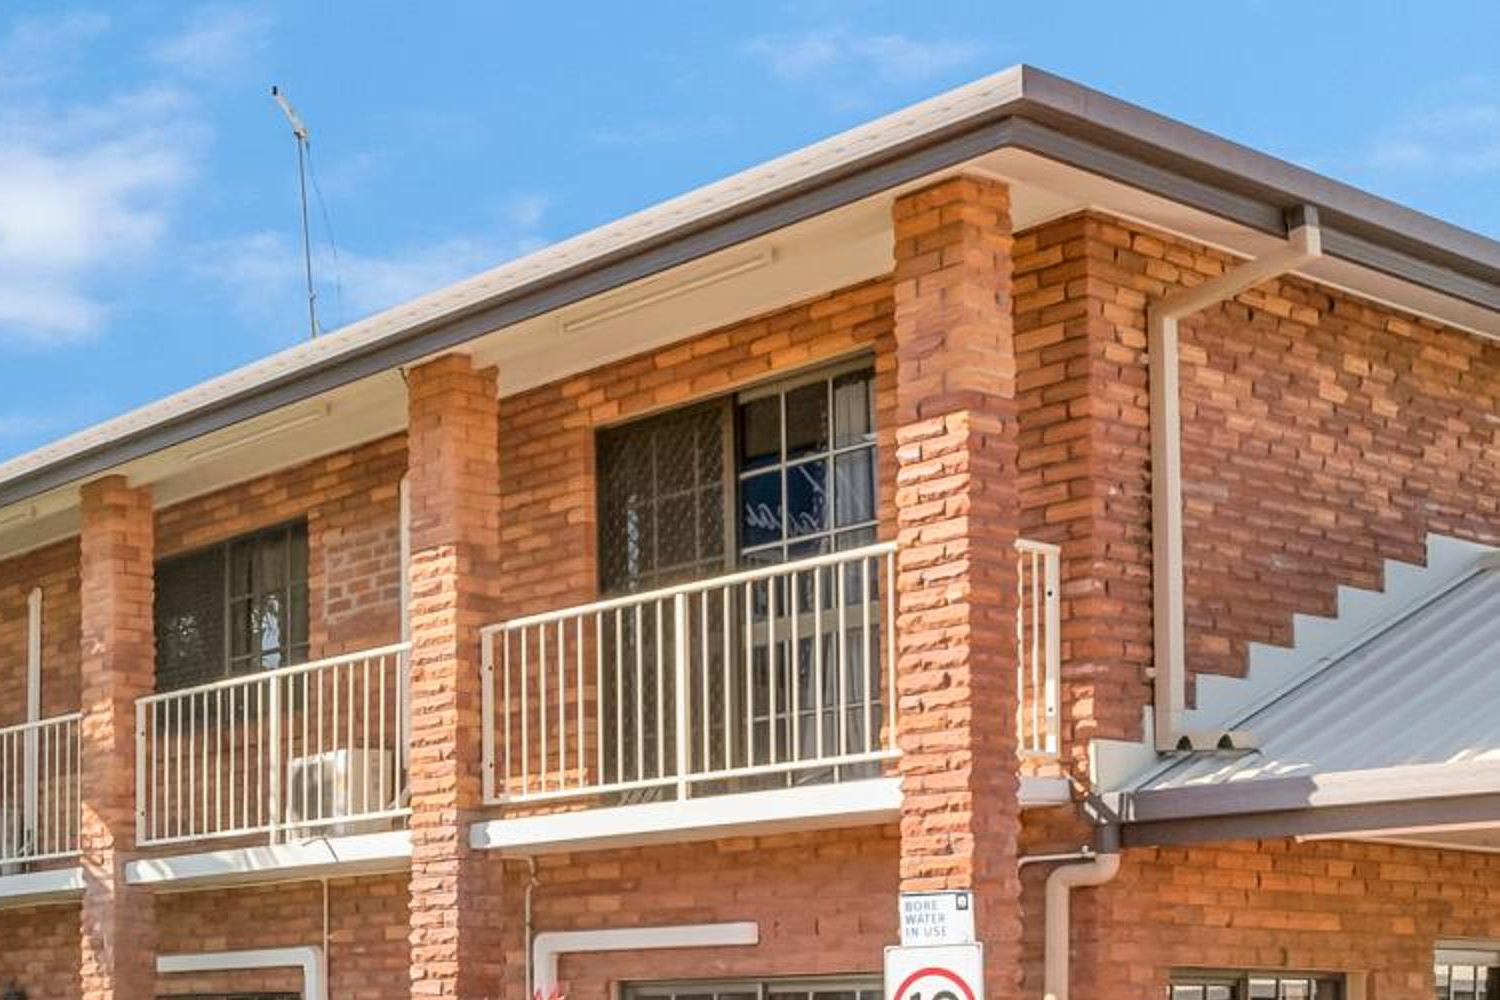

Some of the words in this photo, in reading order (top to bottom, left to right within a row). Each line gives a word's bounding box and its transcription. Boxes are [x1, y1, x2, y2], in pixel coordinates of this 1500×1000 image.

[905, 900, 938, 912] BORE
[905, 913, 947, 925] WATER
[905, 926, 919, 938] IN
[923, 926, 947, 937] USE
